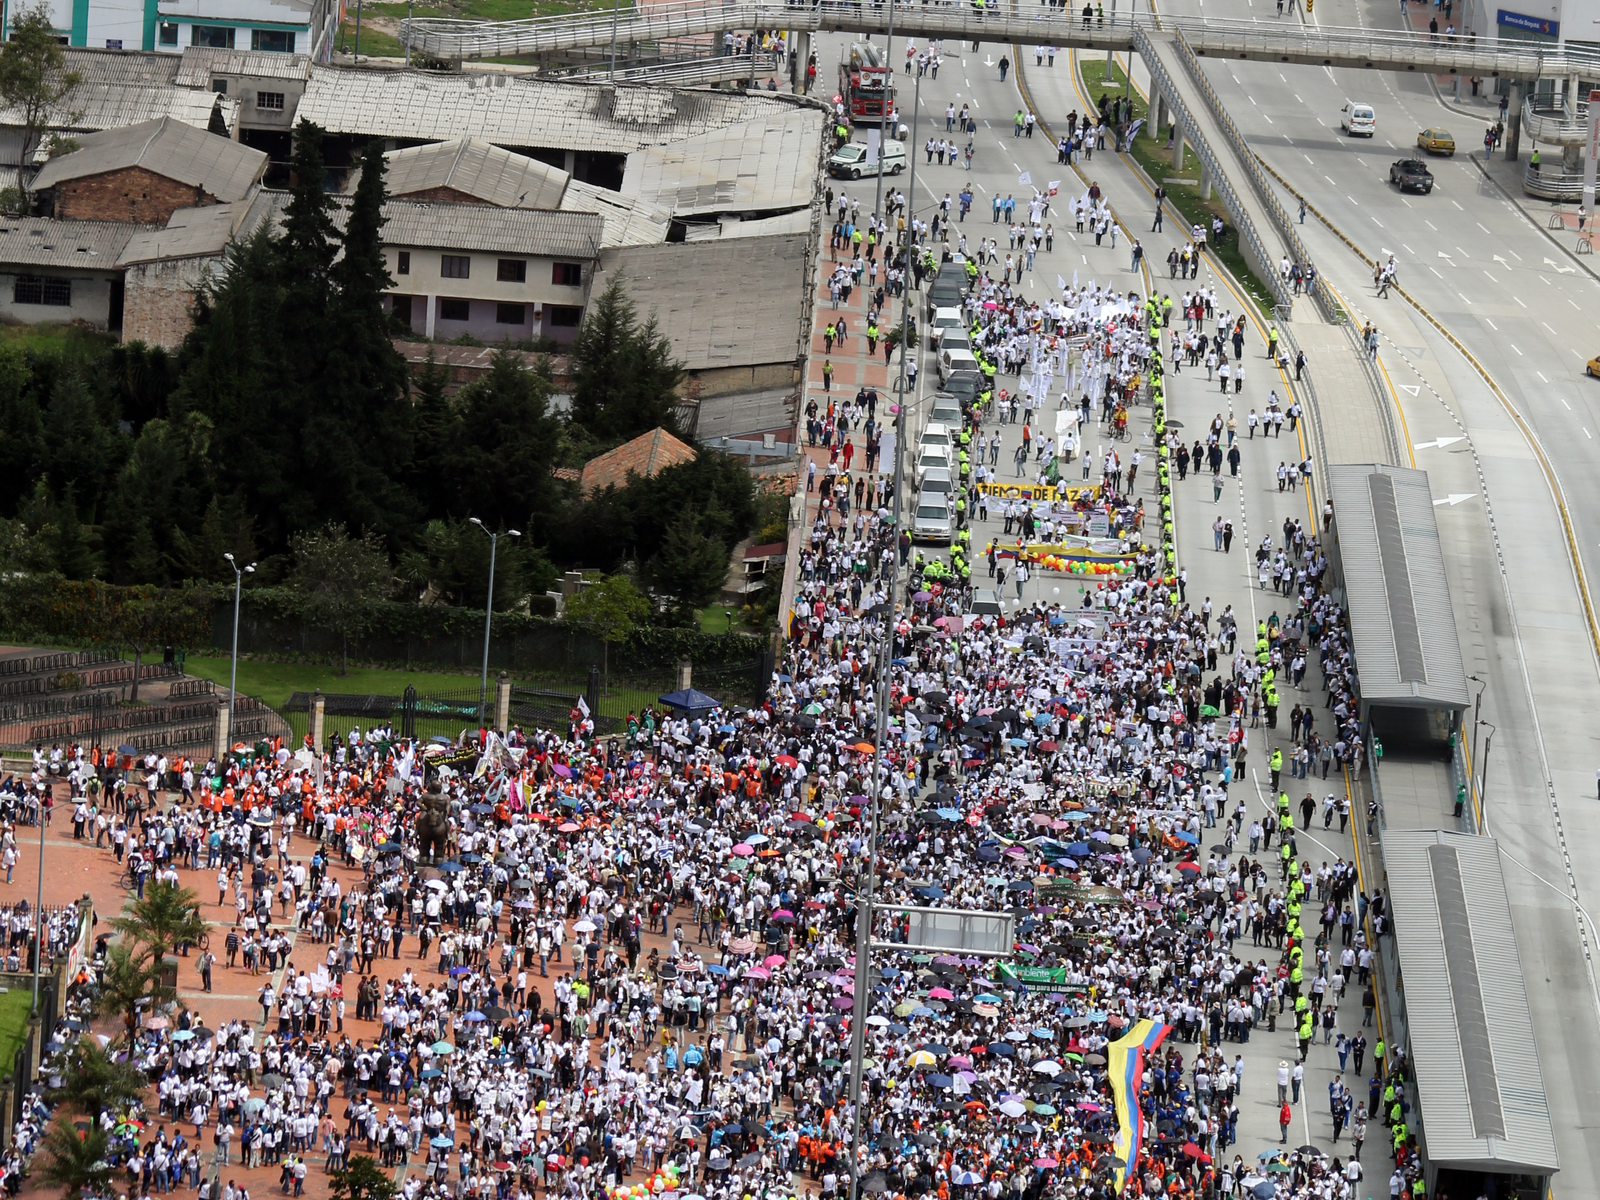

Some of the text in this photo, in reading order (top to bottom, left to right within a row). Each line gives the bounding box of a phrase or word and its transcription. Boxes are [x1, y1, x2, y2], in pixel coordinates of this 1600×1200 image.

[1504, 15, 1518, 23] Banco
[1033, 488, 1048, 502] DE
[1036, 984, 1051, 992] para
